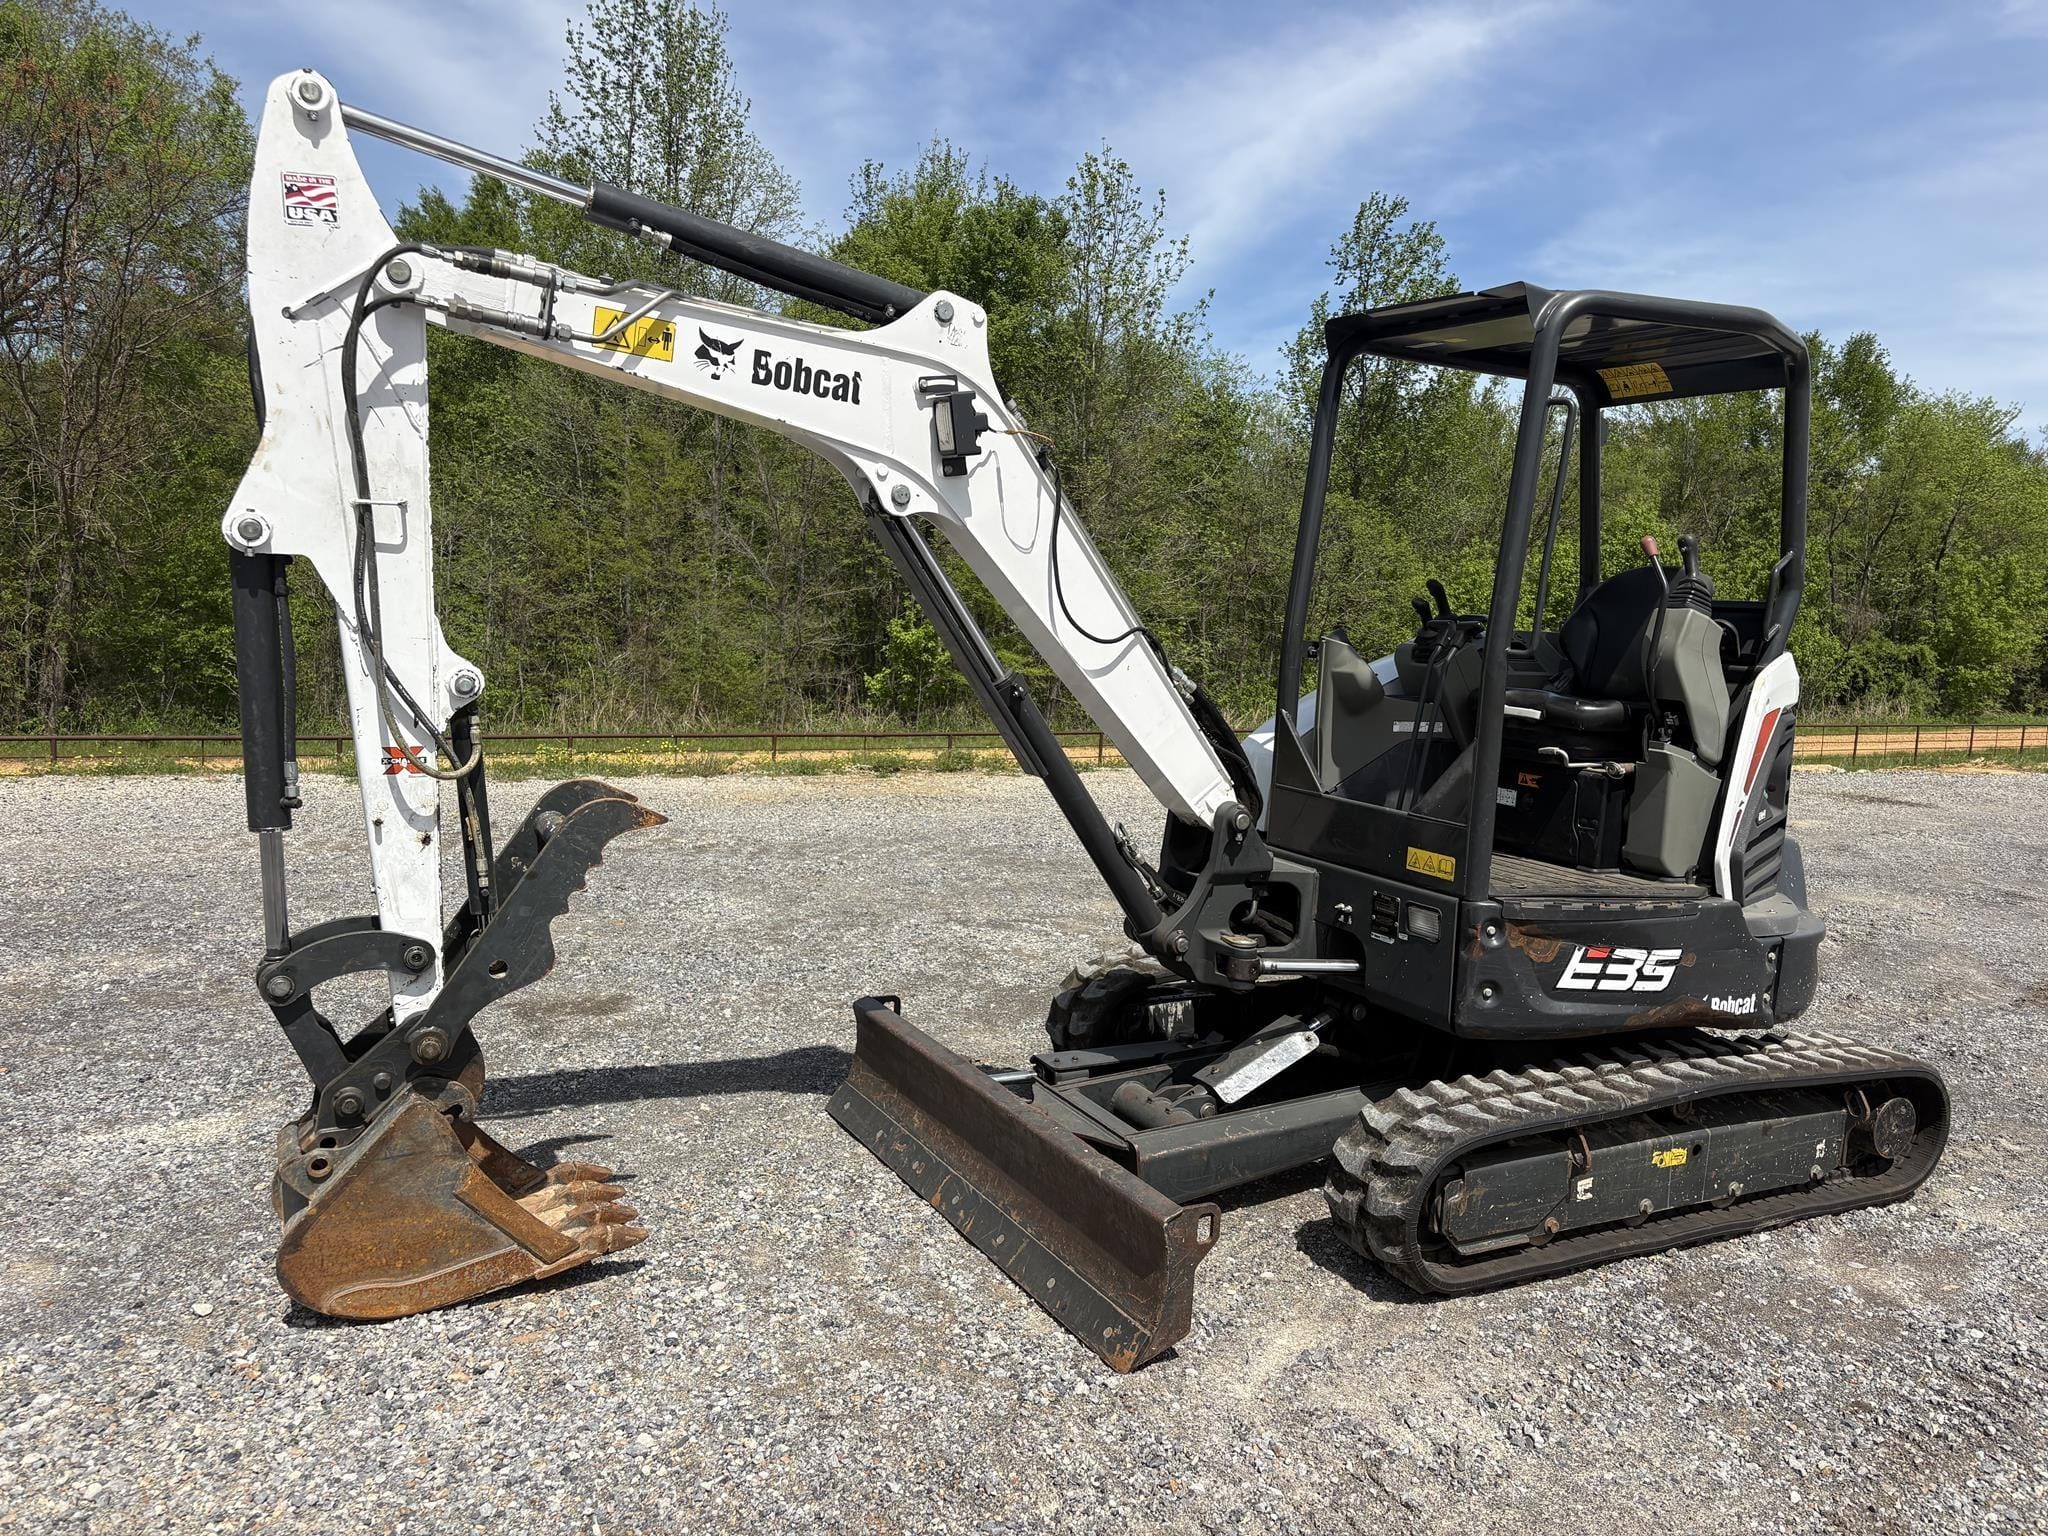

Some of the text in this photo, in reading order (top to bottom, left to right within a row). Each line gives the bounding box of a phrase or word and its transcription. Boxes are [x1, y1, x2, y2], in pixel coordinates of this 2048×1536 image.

[287, 206, 337, 222] USA
[752, 349, 863, 405] Bobcat
[1555, 946, 1683, 992] E35
